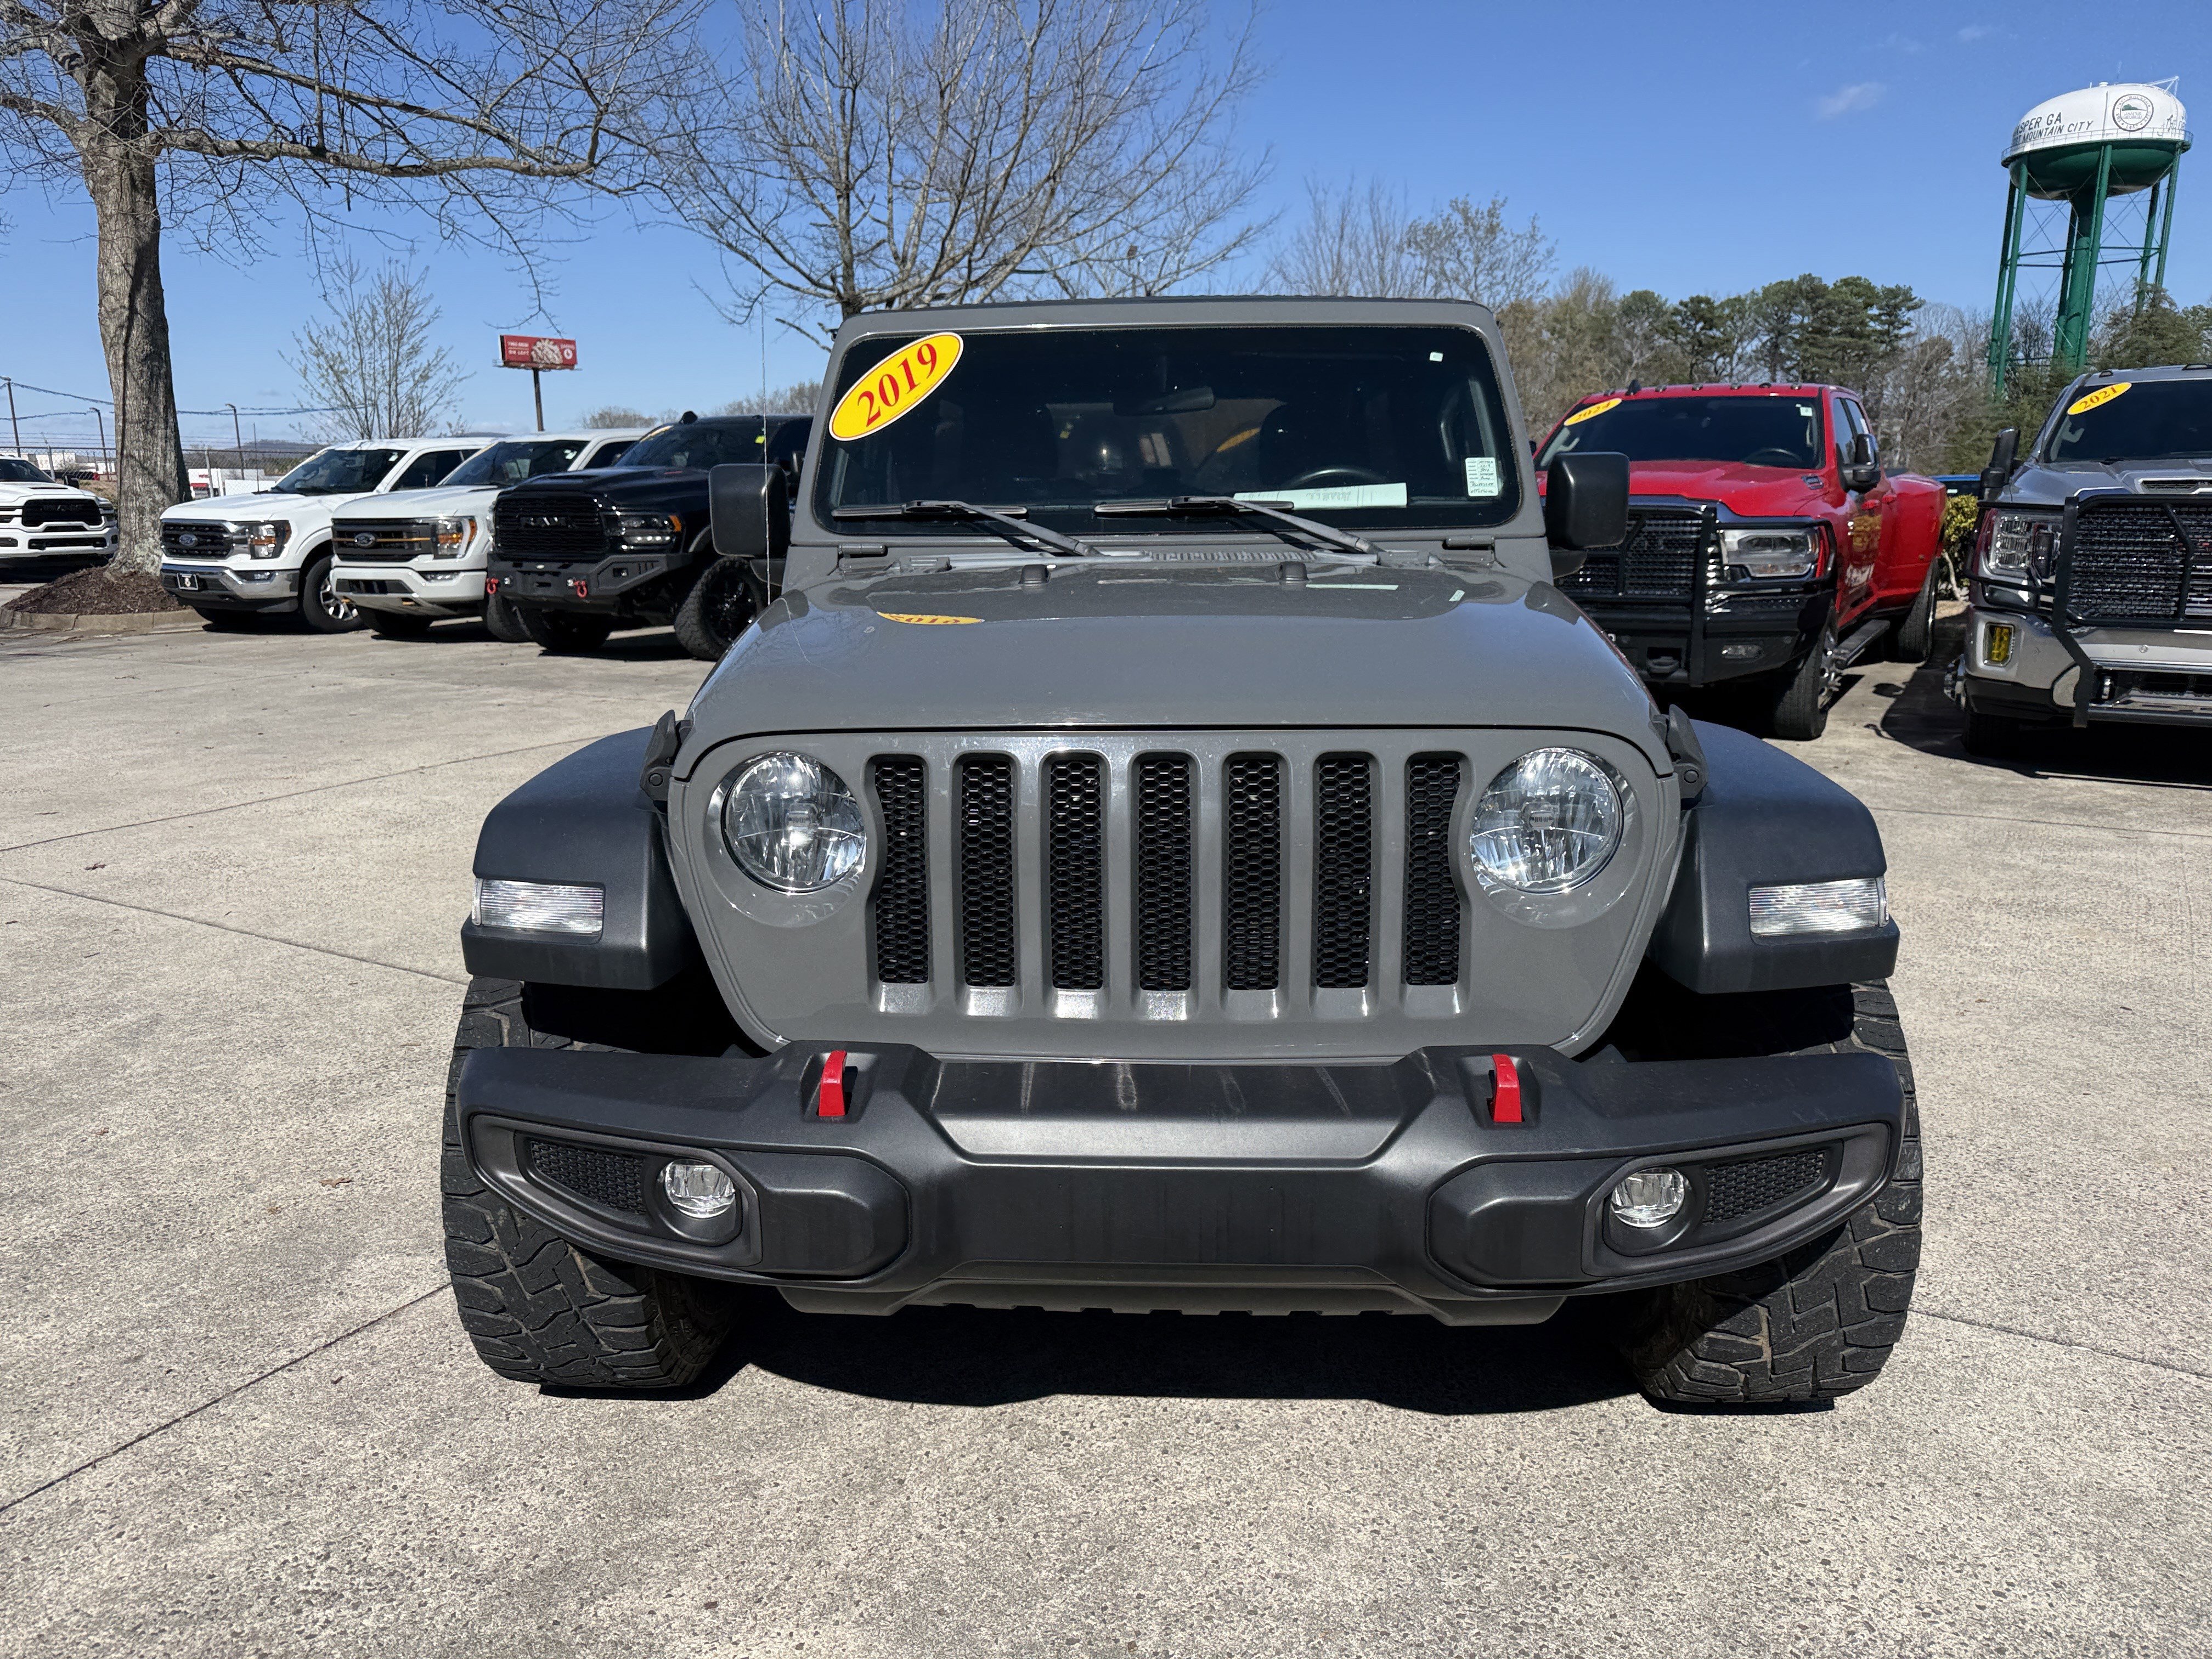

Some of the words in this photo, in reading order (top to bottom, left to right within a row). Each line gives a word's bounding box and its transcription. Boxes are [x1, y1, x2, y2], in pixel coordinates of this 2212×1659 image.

[2046, 112, 2062, 126] GA
[2023, 125, 2064, 143] MOUNTAIN
[2067, 120, 2094, 133] CITY
[857, 343, 937, 427] 2019
[2079, 386, 2118, 409] 2021
